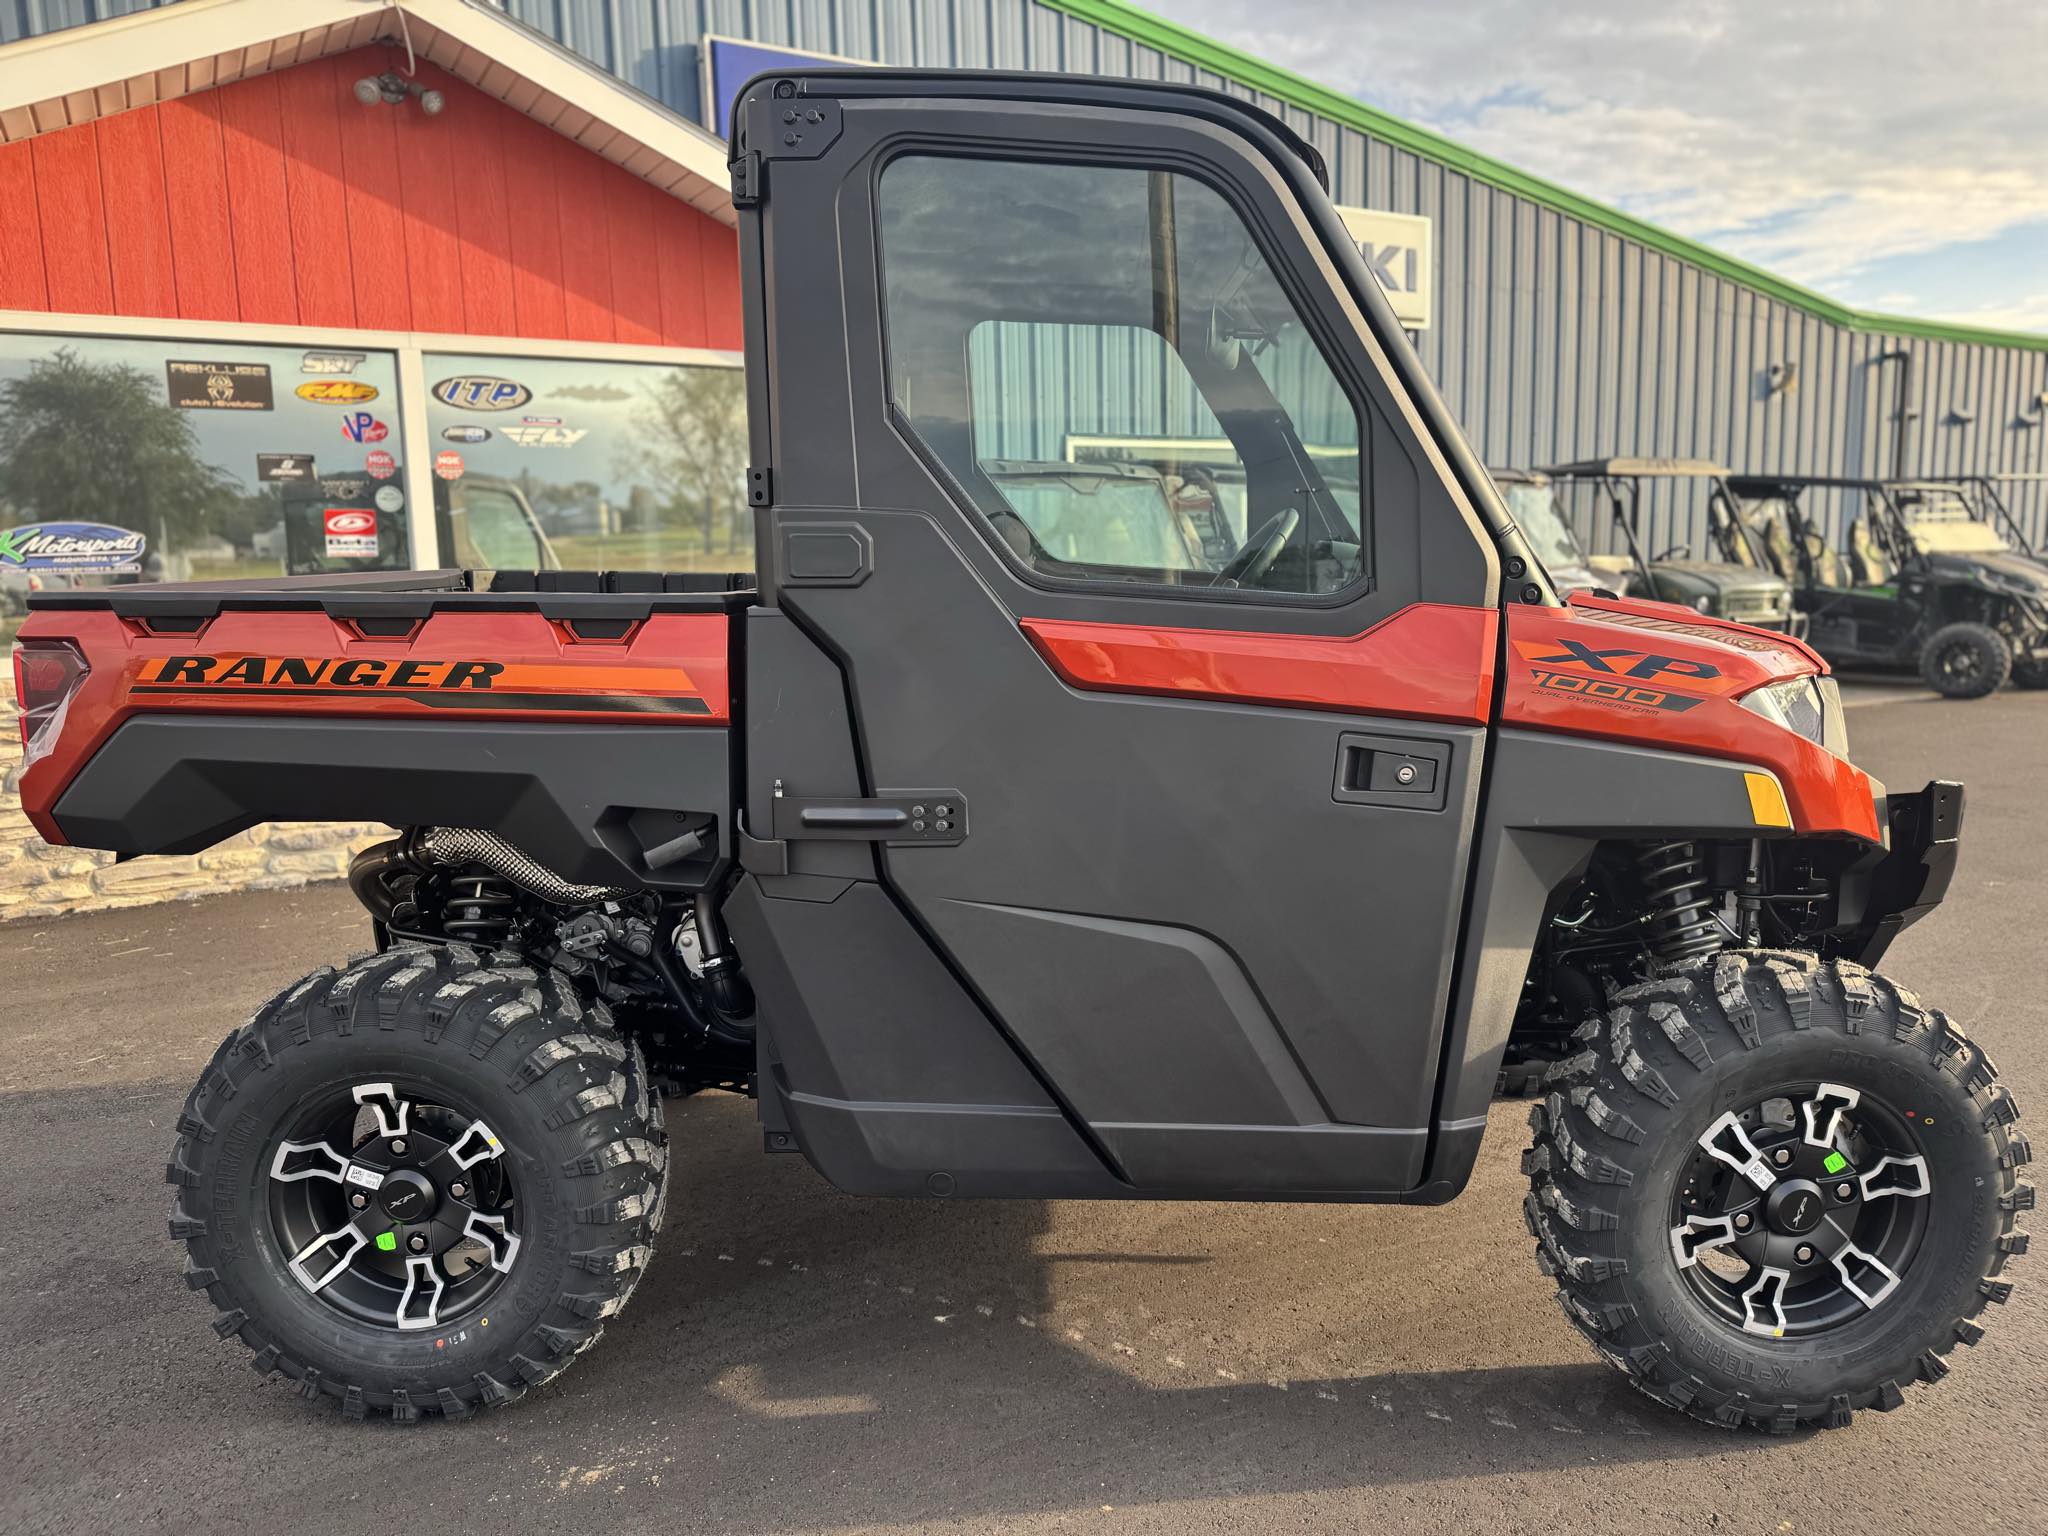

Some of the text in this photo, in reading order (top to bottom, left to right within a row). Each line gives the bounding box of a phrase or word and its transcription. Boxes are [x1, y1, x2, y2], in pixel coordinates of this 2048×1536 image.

[444, 378, 520, 405] ITP
[343, 412, 373, 442] VP
[520, 427, 589, 443] FLY
[153, 655, 506, 689] RANGER
[1528, 638, 1723, 680] XP
[1531, 671, 1666, 707] 1000
[1531, 689, 1660, 716] DUAL OVERHEAD CAM
[215, 1112, 258, 1262] X-TERRAIN
[1665, 1297, 1792, 1389] X-TERRAIN
